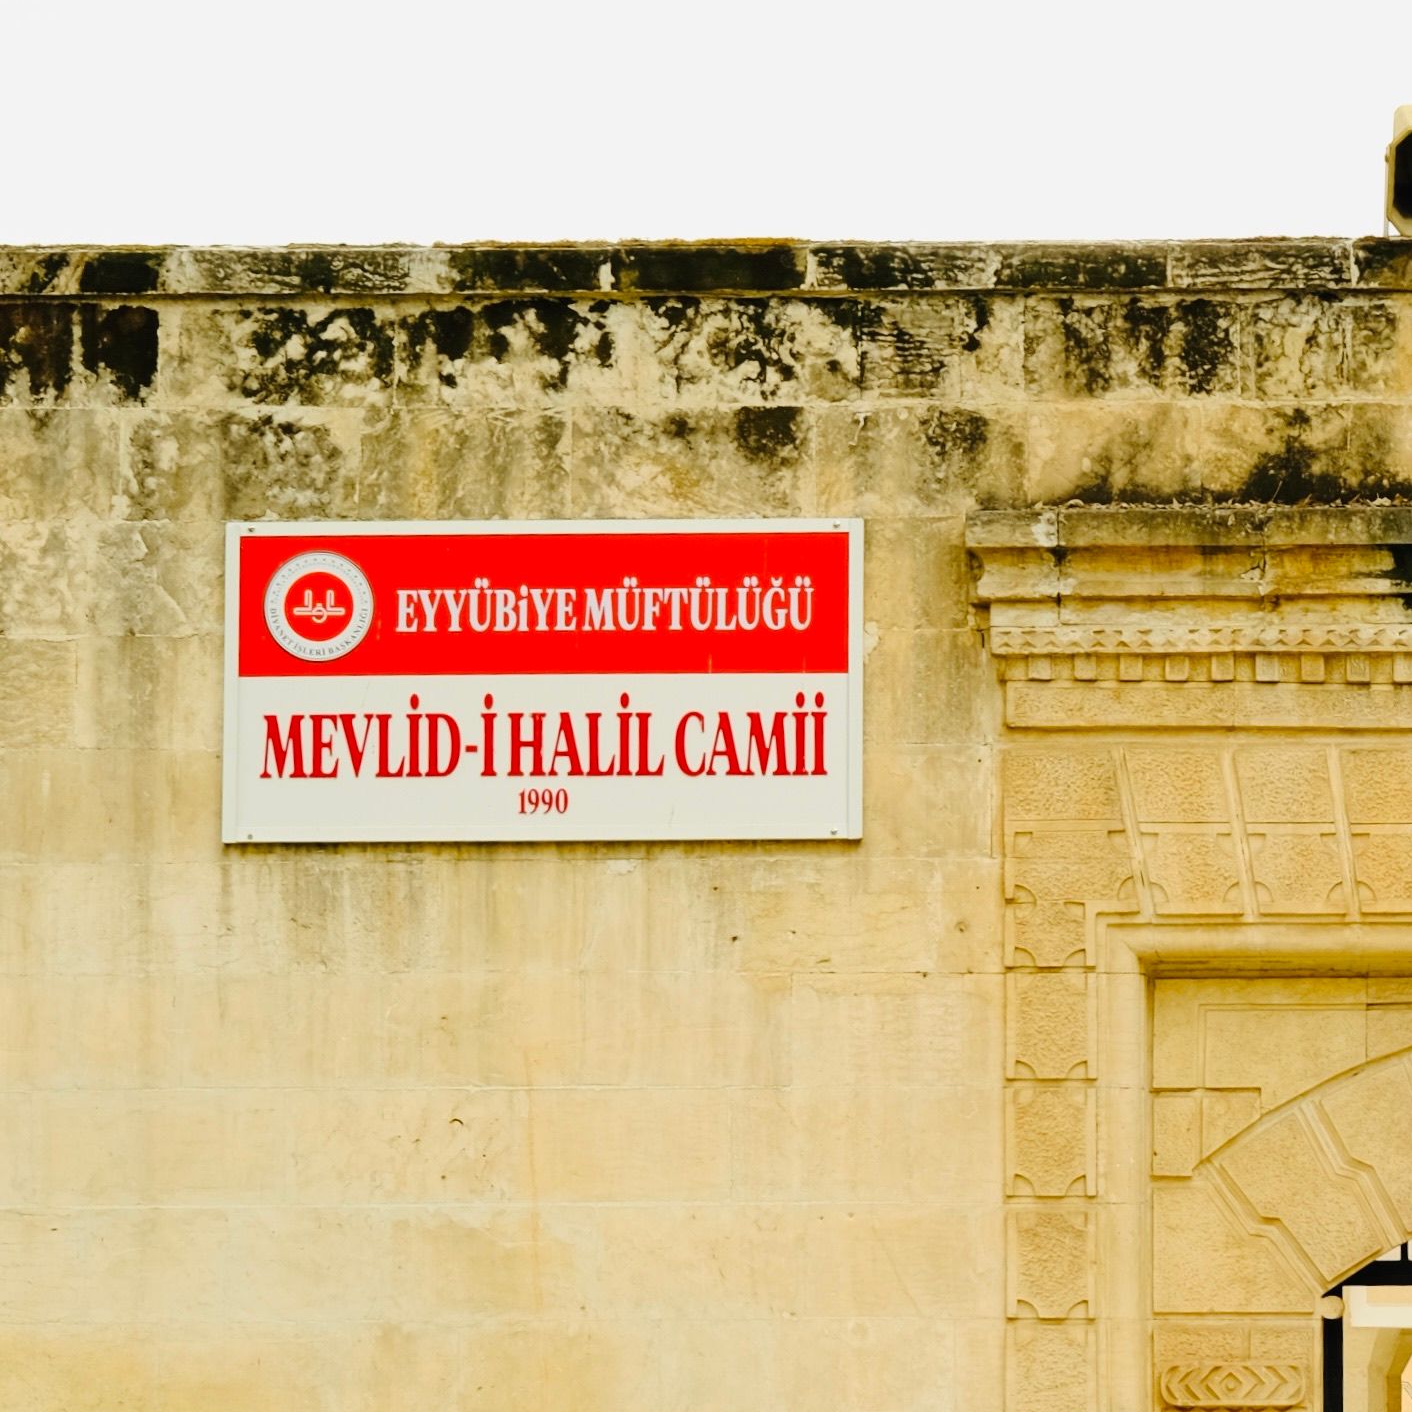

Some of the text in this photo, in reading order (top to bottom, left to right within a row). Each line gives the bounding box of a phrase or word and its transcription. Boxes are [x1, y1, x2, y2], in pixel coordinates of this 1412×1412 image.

[582, 576, 814, 631] MÜFTÜLÜĞÜ
[260, 691, 828, 778] MEVLİD-İ HALİL CAMİİ
[518, 788, 568, 815] 1990
